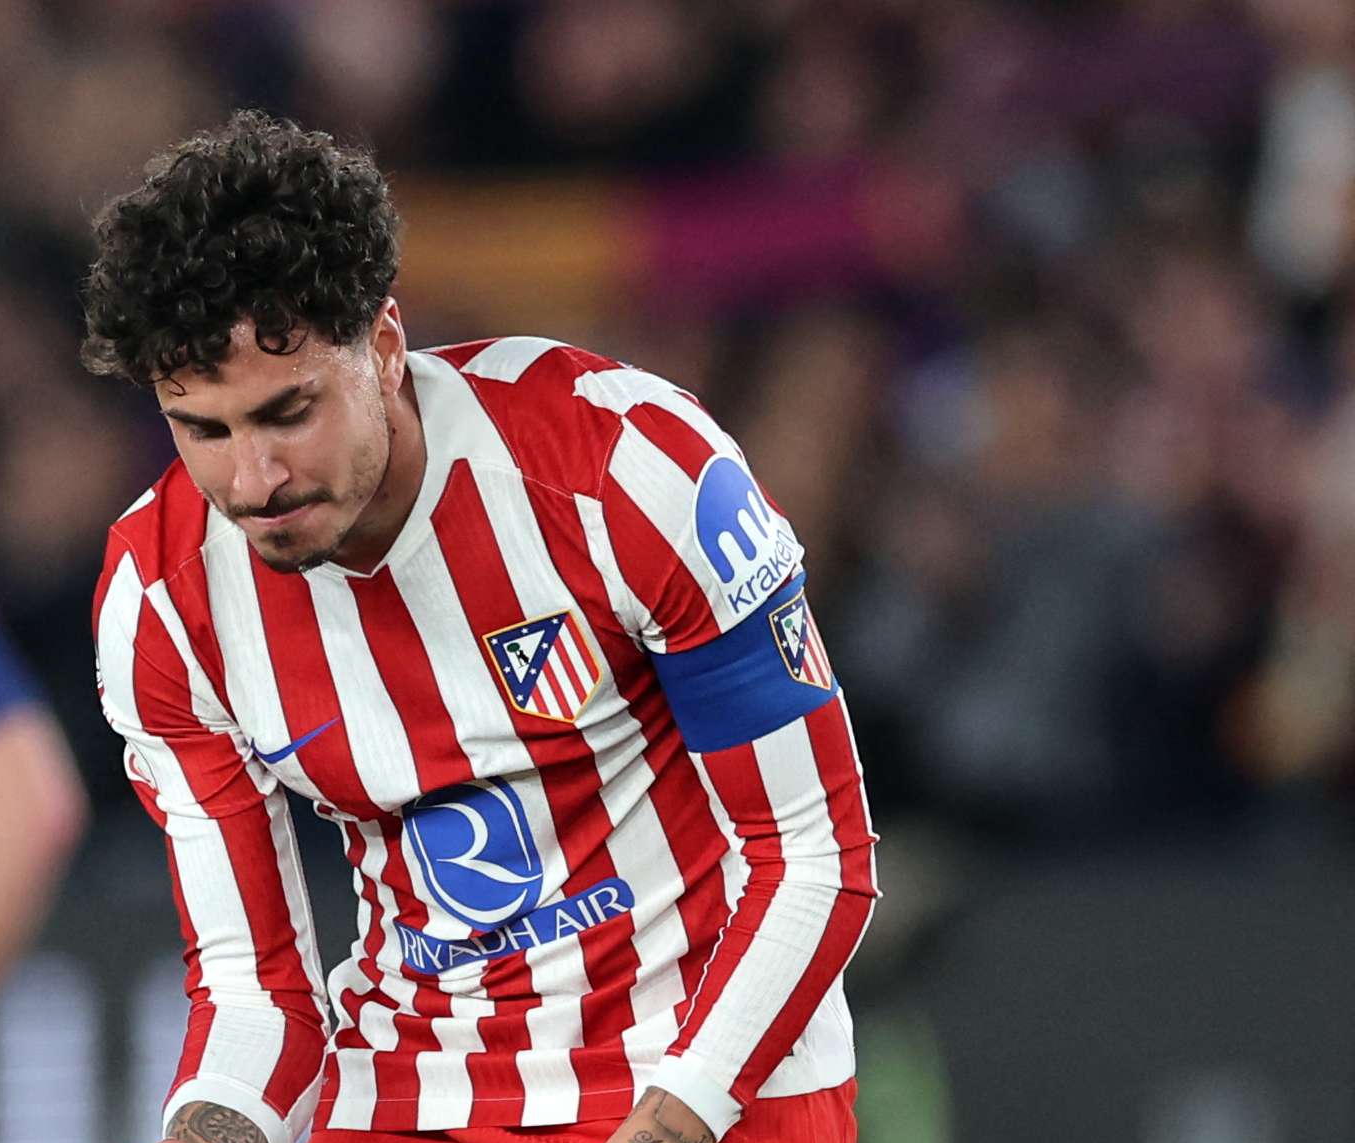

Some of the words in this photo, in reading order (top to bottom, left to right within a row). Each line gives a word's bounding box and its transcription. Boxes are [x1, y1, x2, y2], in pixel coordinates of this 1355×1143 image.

[727, 529, 796, 614] kraken
[399, 917, 540, 970] RIYADH
[555, 886, 630, 942] AIR
